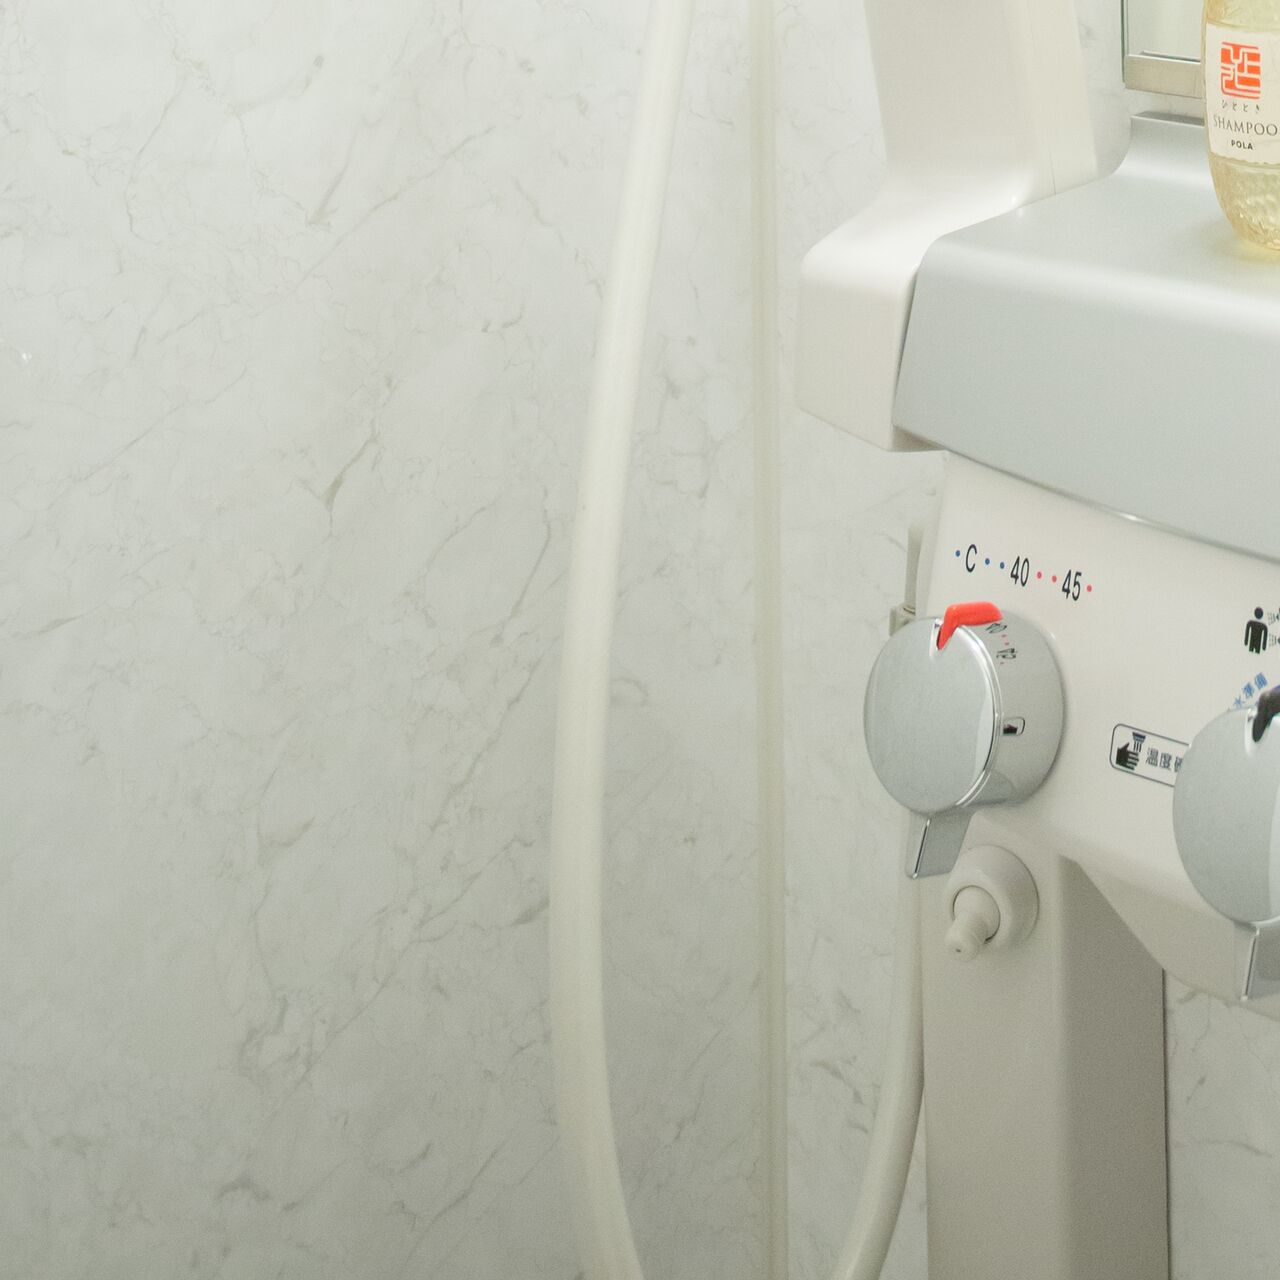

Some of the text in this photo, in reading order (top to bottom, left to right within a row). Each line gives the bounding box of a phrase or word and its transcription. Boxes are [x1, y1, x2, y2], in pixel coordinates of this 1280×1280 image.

[1213, 114, 1278, 137] SHAMPOO
[1231, 139, 1253, 150] POLA
[1010, 555, 1030, 587] 40
[1061, 569, 1082, 602] 45
